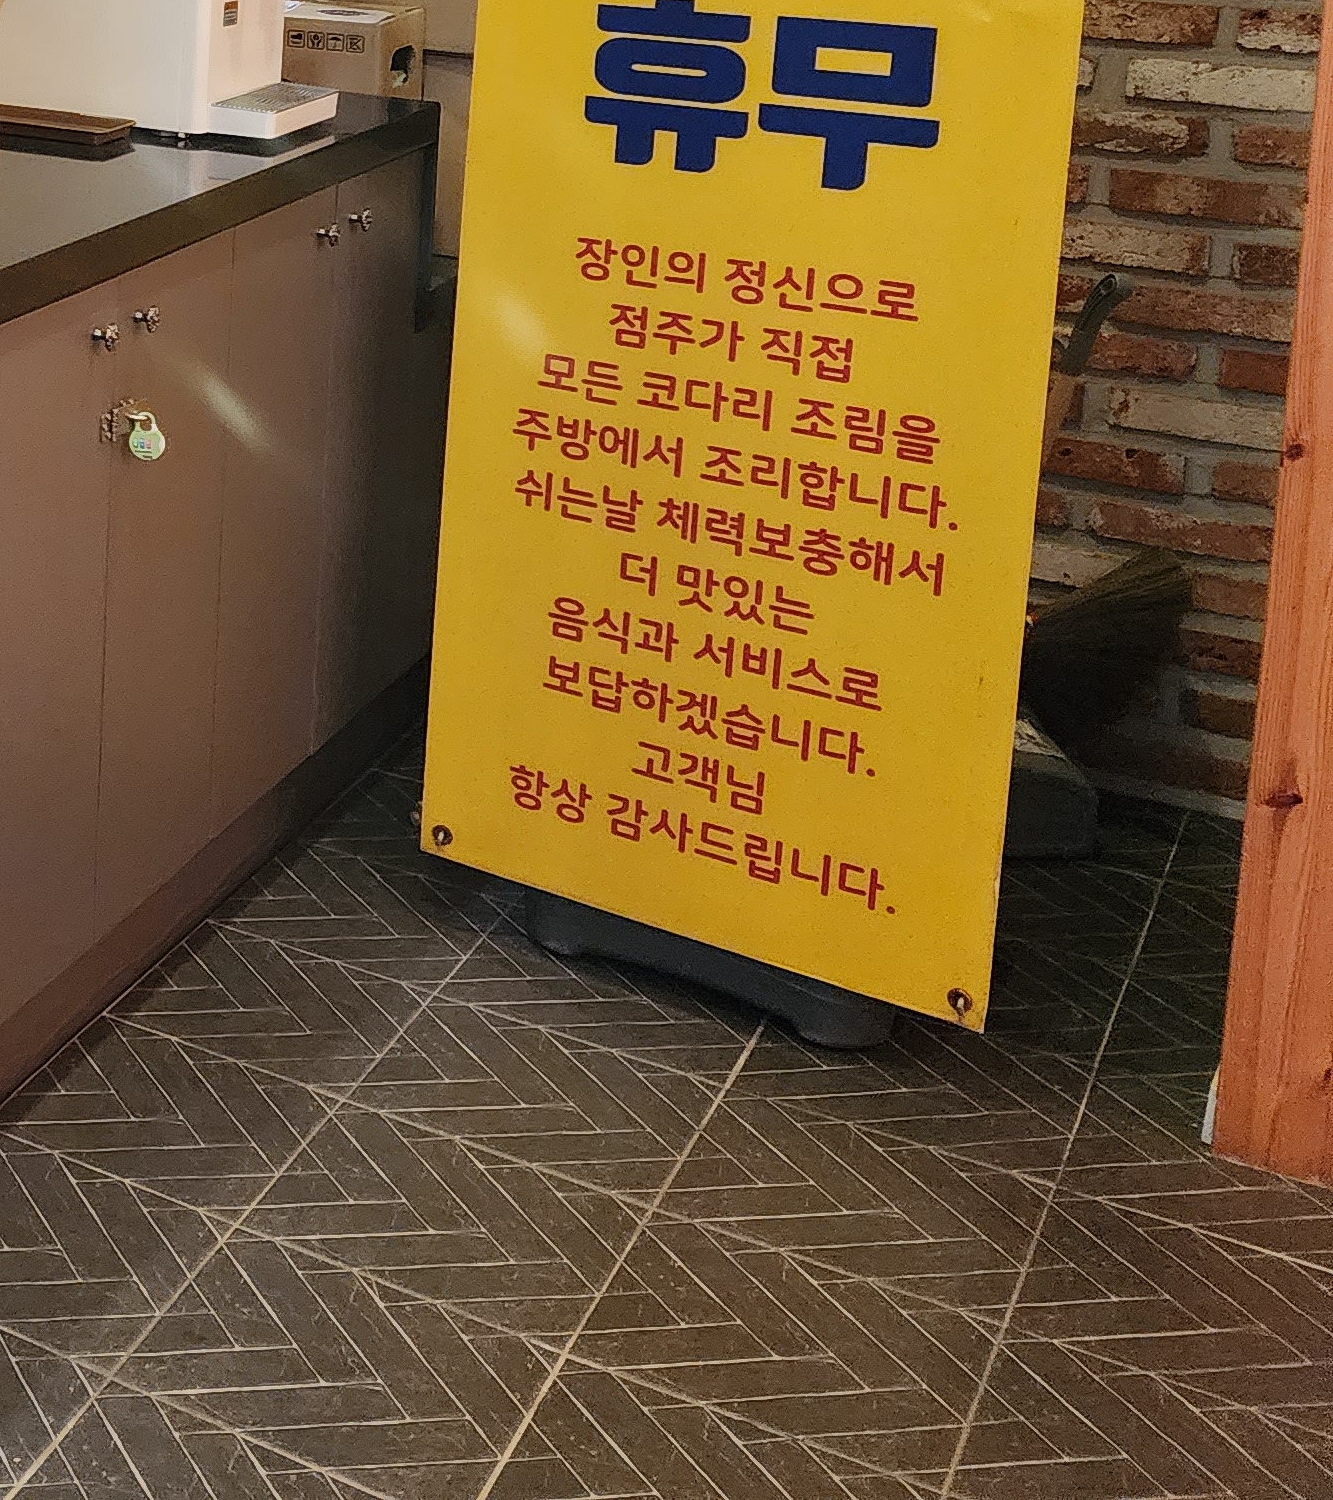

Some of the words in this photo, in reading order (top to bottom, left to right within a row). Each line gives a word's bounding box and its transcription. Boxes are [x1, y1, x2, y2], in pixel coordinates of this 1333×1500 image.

[575, 237, 707, 293] 장인의
[724, 258, 918, 322] 정신으로
[609, 303, 745, 362] 점주가
[760, 327, 854, 384] 직접
[538, 354, 622, 405] 모든
[637, 371, 773, 432] 코다리
[791, 397, 940, 465] 조림을
[513, 407, 684, 478] 주방에서
[700, 445, 958, 531] 조리합니다.
[516, 469, 644, 533] 쉬는날
[656, 497, 945, 597] 체력보충해서
[619, 552, 658, 597] 더
[676, 564, 814, 635] 맛있는
[548, 596, 679, 662] 음식과
[693, 634, 882, 711] 서비스로
[543, 655, 875, 777] 보답하겠습니다.
[633, 741, 766, 816] 고객님
[510, 764, 592, 824] 항상
[607, 793, 895, 914] 감사드립니다.
